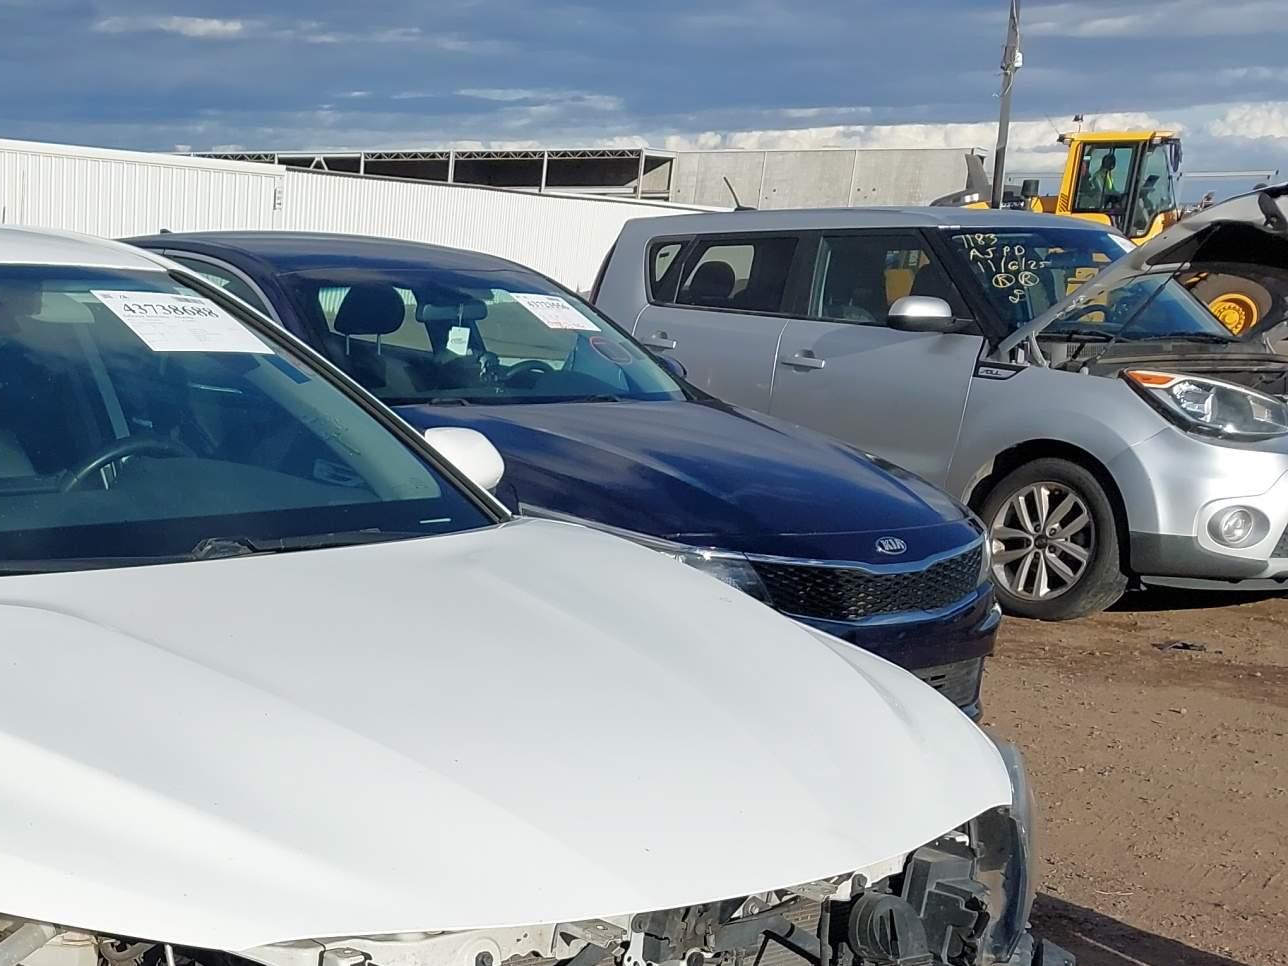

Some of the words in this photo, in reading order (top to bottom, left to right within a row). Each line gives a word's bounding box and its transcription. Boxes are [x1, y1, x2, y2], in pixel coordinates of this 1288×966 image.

[952, 233, 998, 248] 7183
[123, 303, 219, 318] 43738688
[879, 538, 905, 551] KIA
